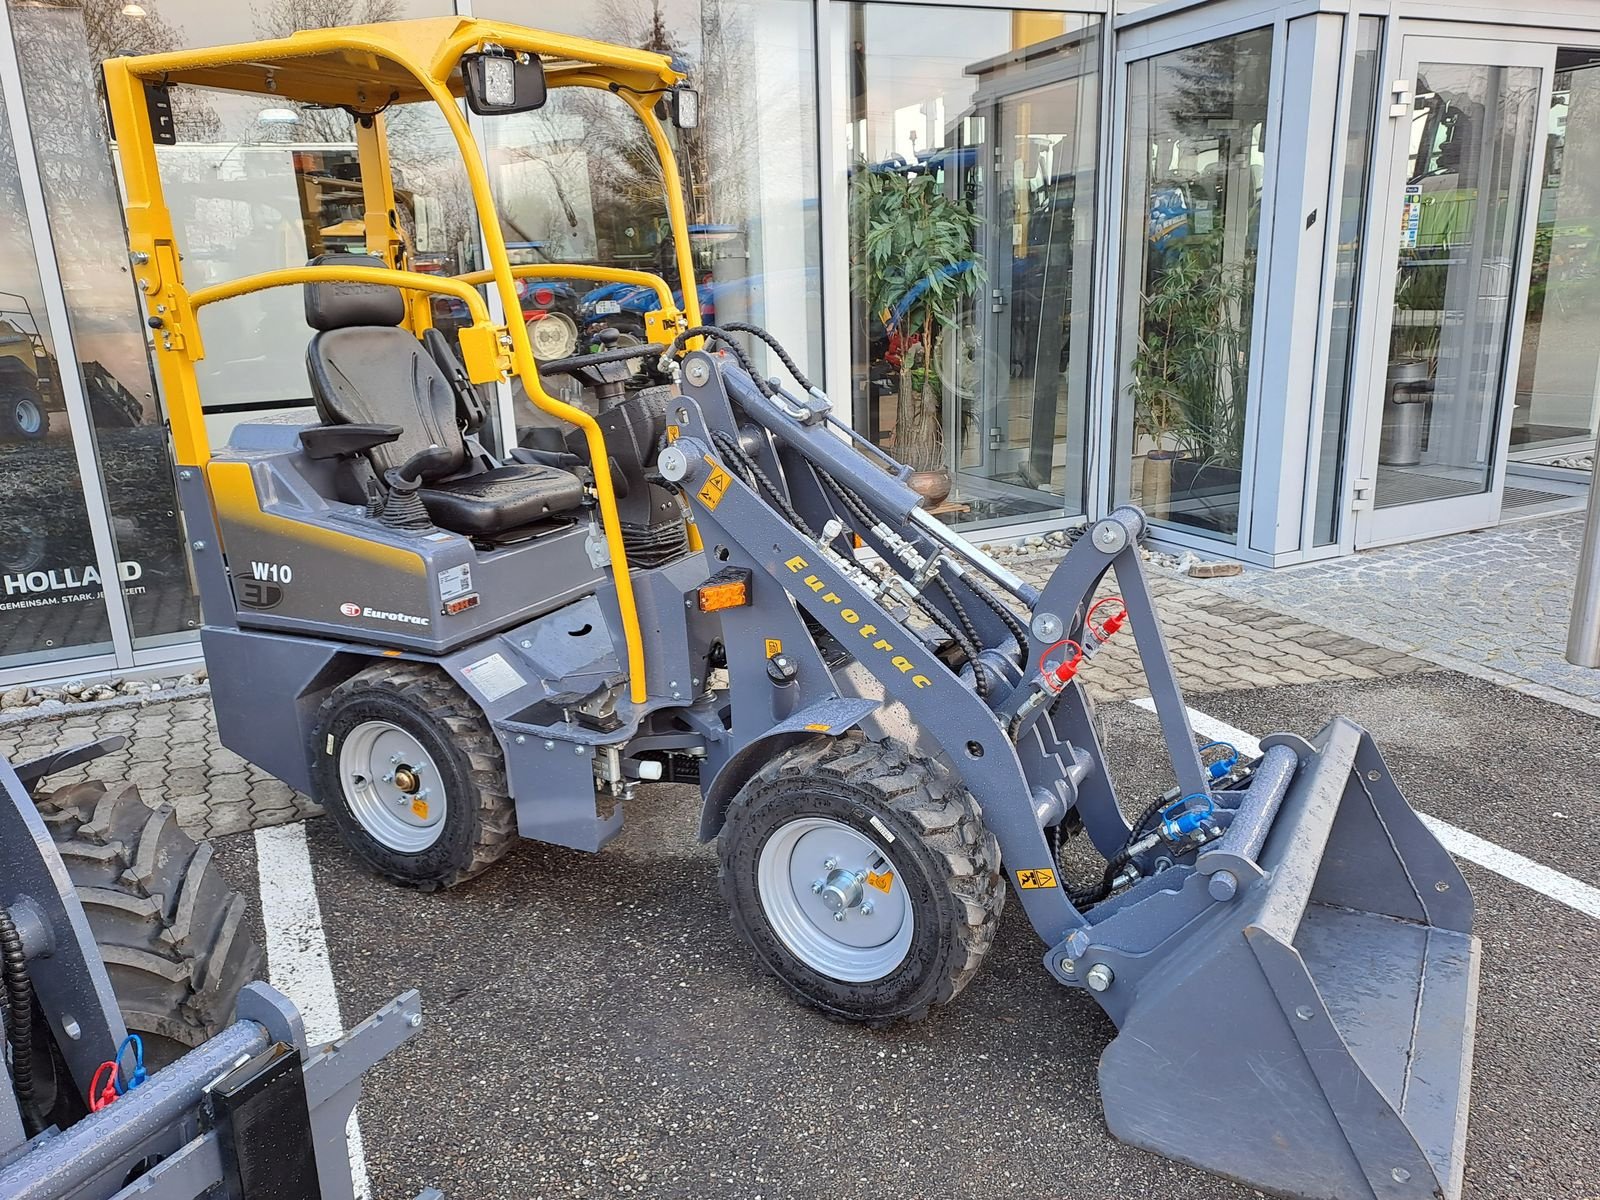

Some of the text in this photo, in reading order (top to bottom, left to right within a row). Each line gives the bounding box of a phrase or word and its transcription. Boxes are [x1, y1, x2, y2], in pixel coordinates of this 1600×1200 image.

[3, 561, 142, 595] HOLLAD
[251, 561, 292, 584] W10
[0, 598, 60, 611] GEMEINSAM.
[61, 593, 96, 604] STARK.
[363, 607, 430, 626] Eurotrac
[784, 555, 932, 689] Eurotrac
